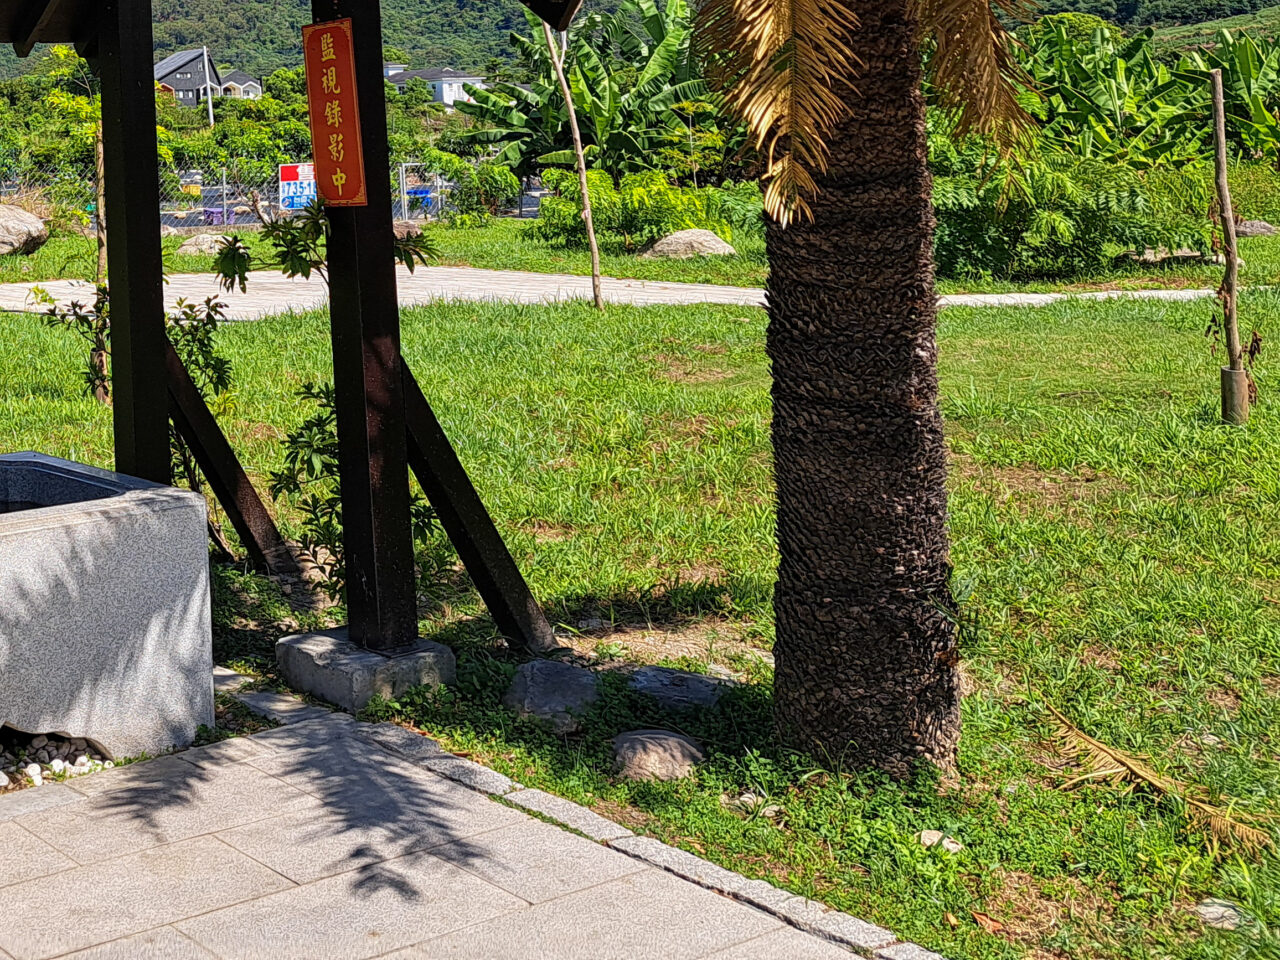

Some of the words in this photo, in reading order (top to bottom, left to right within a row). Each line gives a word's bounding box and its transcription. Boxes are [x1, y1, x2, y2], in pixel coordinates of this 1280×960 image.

[320, 32, 347, 197] 監視錄影中
